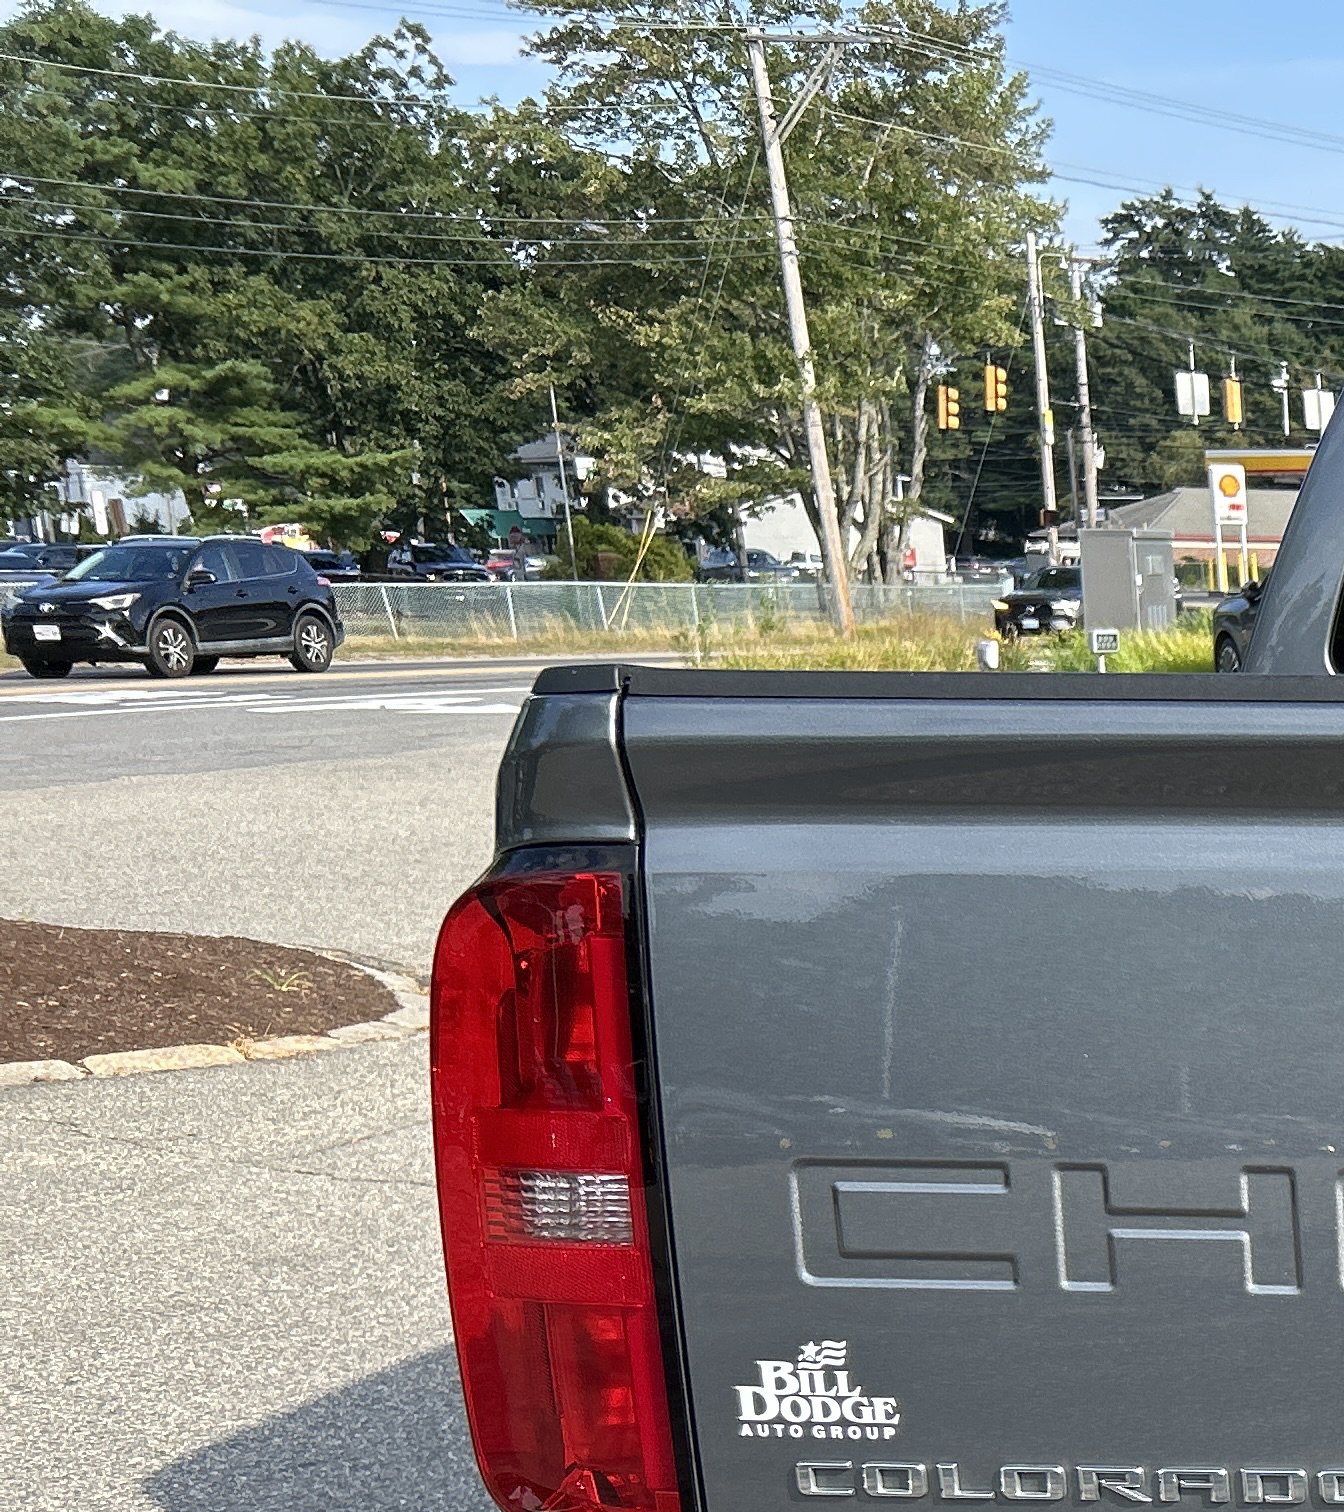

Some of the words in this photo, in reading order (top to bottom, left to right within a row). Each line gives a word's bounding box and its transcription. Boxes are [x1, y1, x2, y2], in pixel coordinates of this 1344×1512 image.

[753, 1360, 862, 1397] BILL
[732, 1385, 901, 1425] DODGE
[740, 1423, 804, 1438] AUTO
[812, 1425, 896, 1440] GROUP
